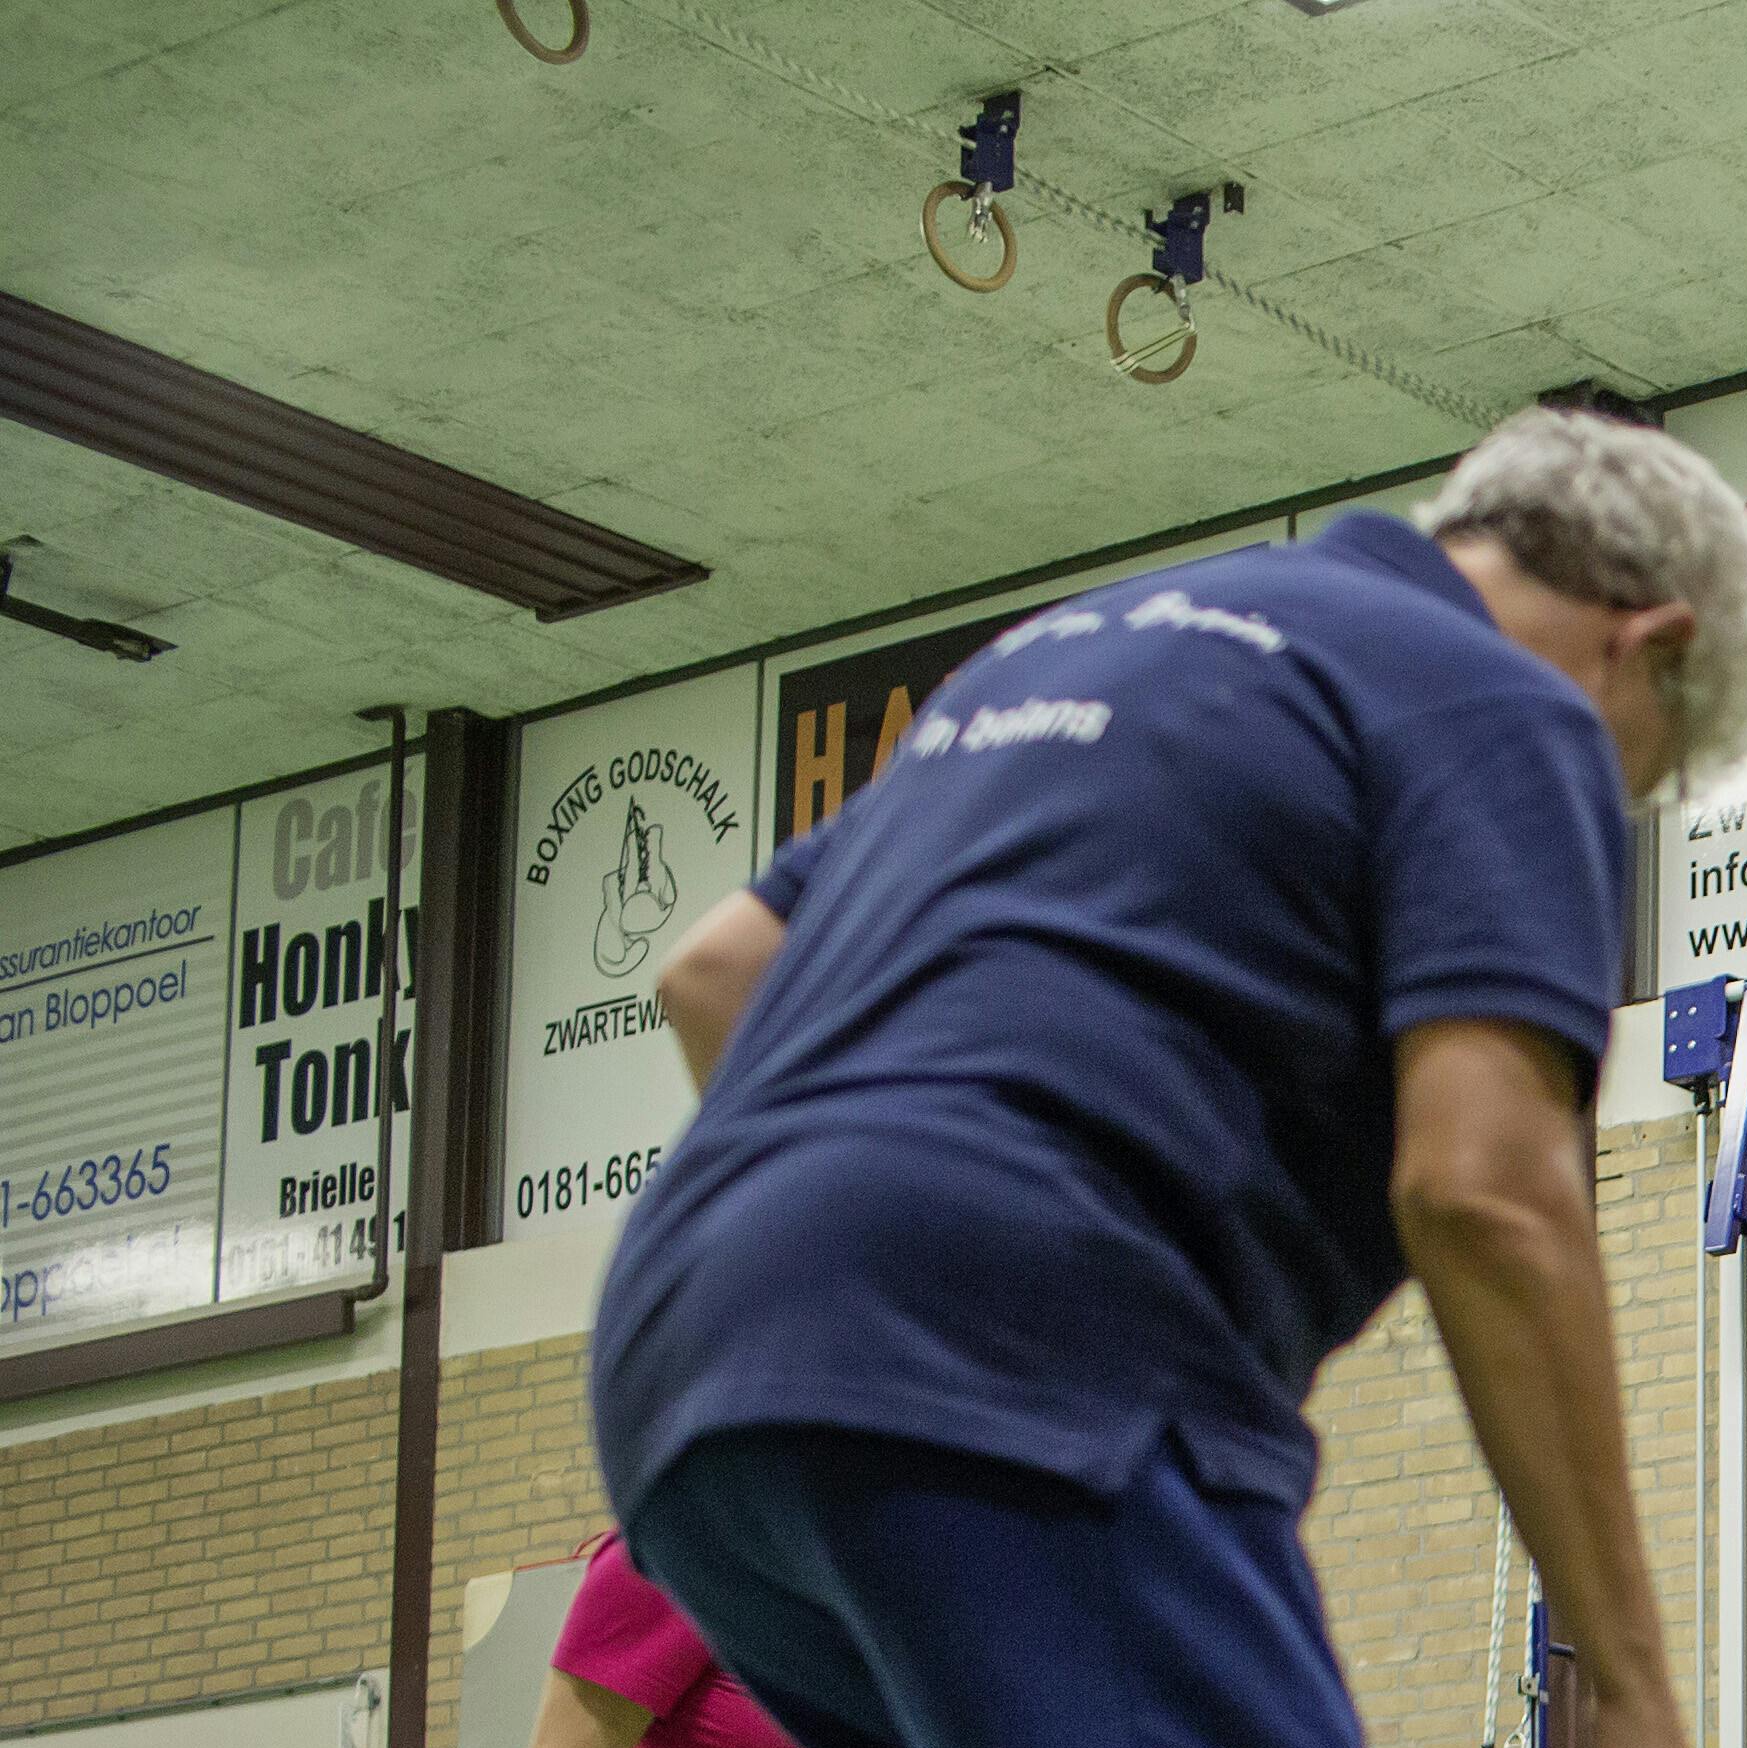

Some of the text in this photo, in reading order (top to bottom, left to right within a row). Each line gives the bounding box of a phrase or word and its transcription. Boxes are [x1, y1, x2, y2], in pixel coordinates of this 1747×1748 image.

[526, 747, 738, 886] BOXING GODSCHALK
[45, 959, 188, 1031] Bloppoel
[255, 1017, 412, 1144] Tonk
[1, 1142, 171, 1228] 1-663365
[279, 1161, 376, 1220] Brielle
